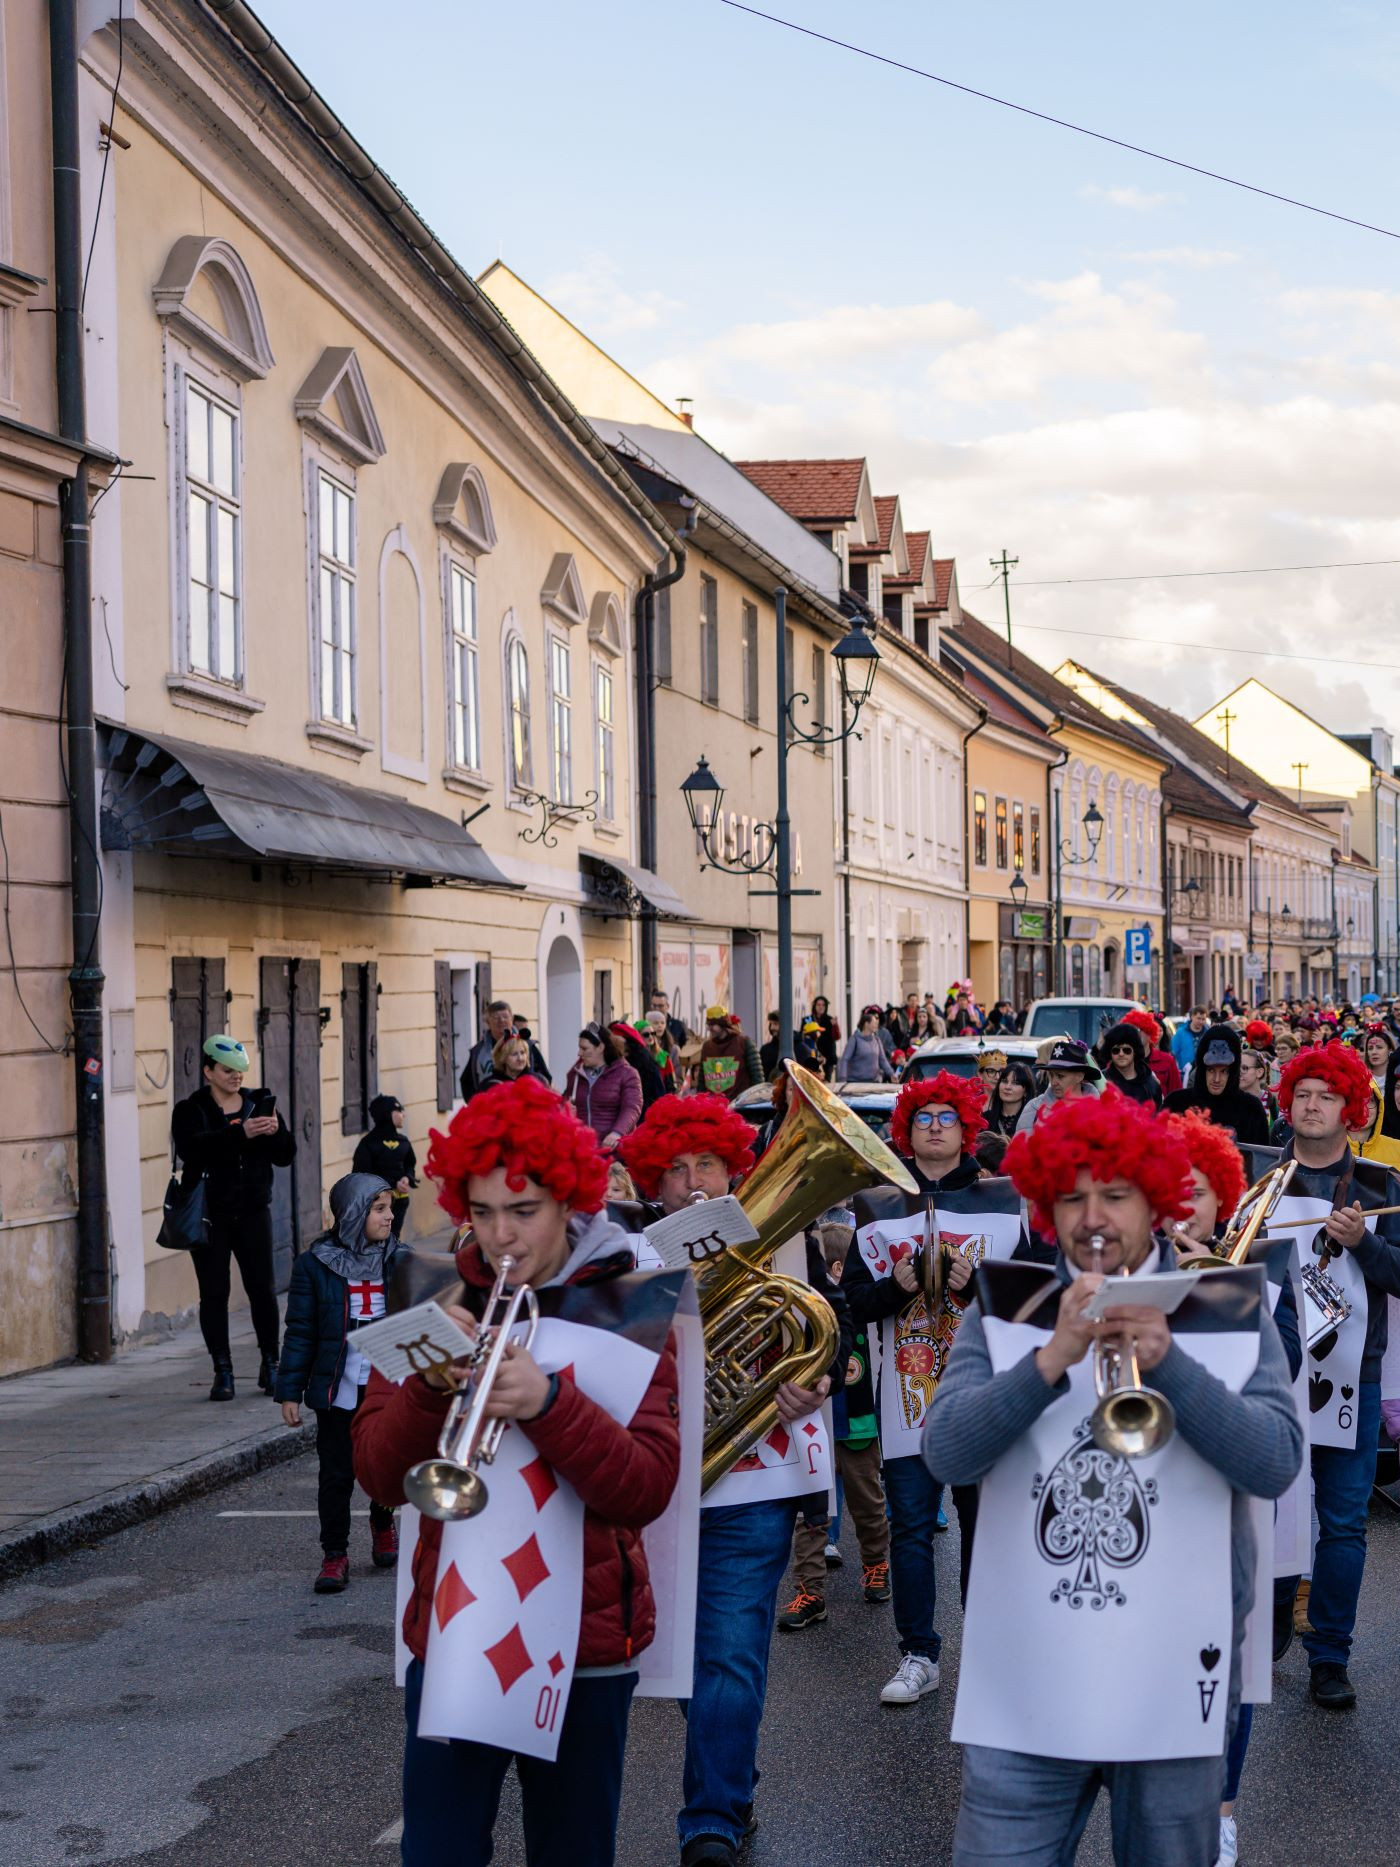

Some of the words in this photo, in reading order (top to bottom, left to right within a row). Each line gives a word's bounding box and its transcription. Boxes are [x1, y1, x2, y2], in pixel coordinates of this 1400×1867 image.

[1130, 932, 1145, 953] P
[866, 1235, 879, 1259] J
[807, 1442, 823, 1475] J
[535, 1685, 561, 1733] 10
[1198, 1680, 1219, 1723] A
